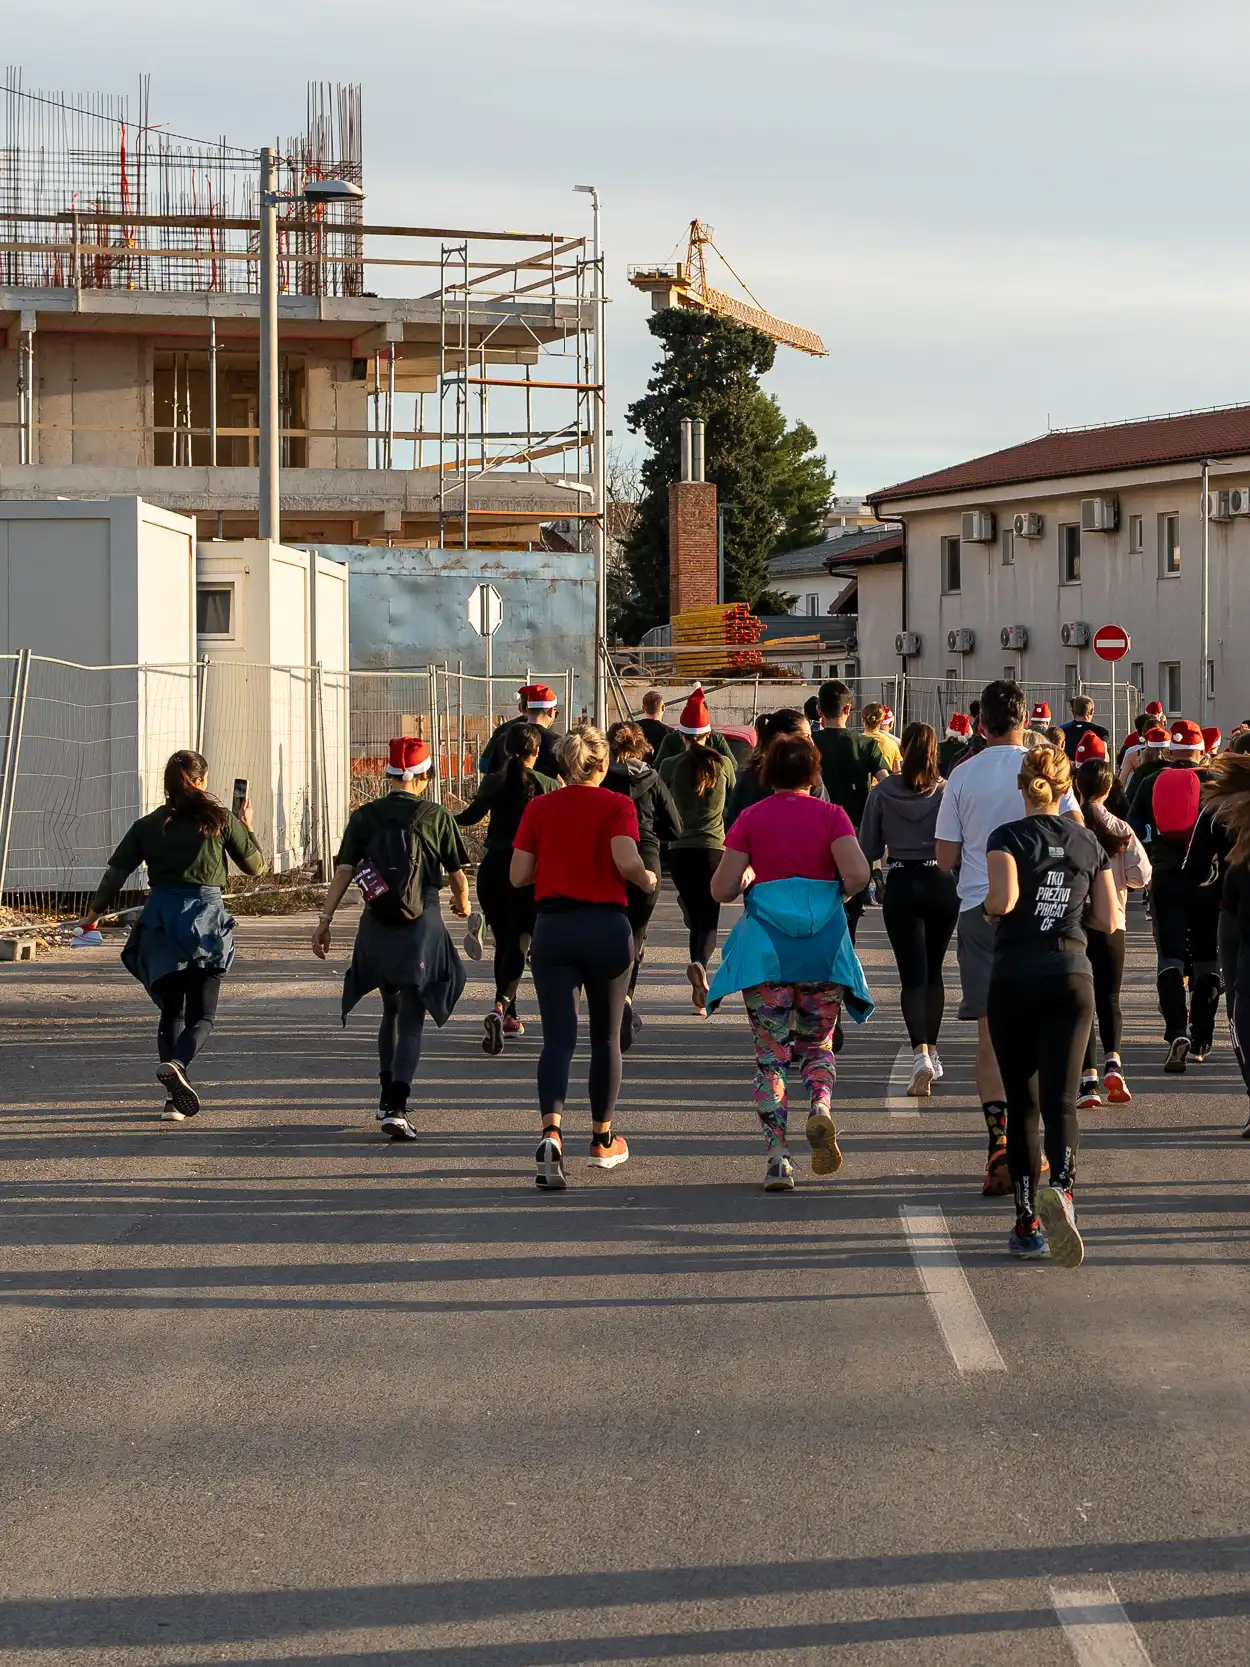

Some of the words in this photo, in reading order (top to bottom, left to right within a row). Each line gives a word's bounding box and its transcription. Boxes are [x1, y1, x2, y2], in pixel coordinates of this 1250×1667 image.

[1046, 870, 1065, 886] TKO
[1035, 885, 1072, 903] PREŽIVI
[1034, 901, 1068, 918] PRIČAT
